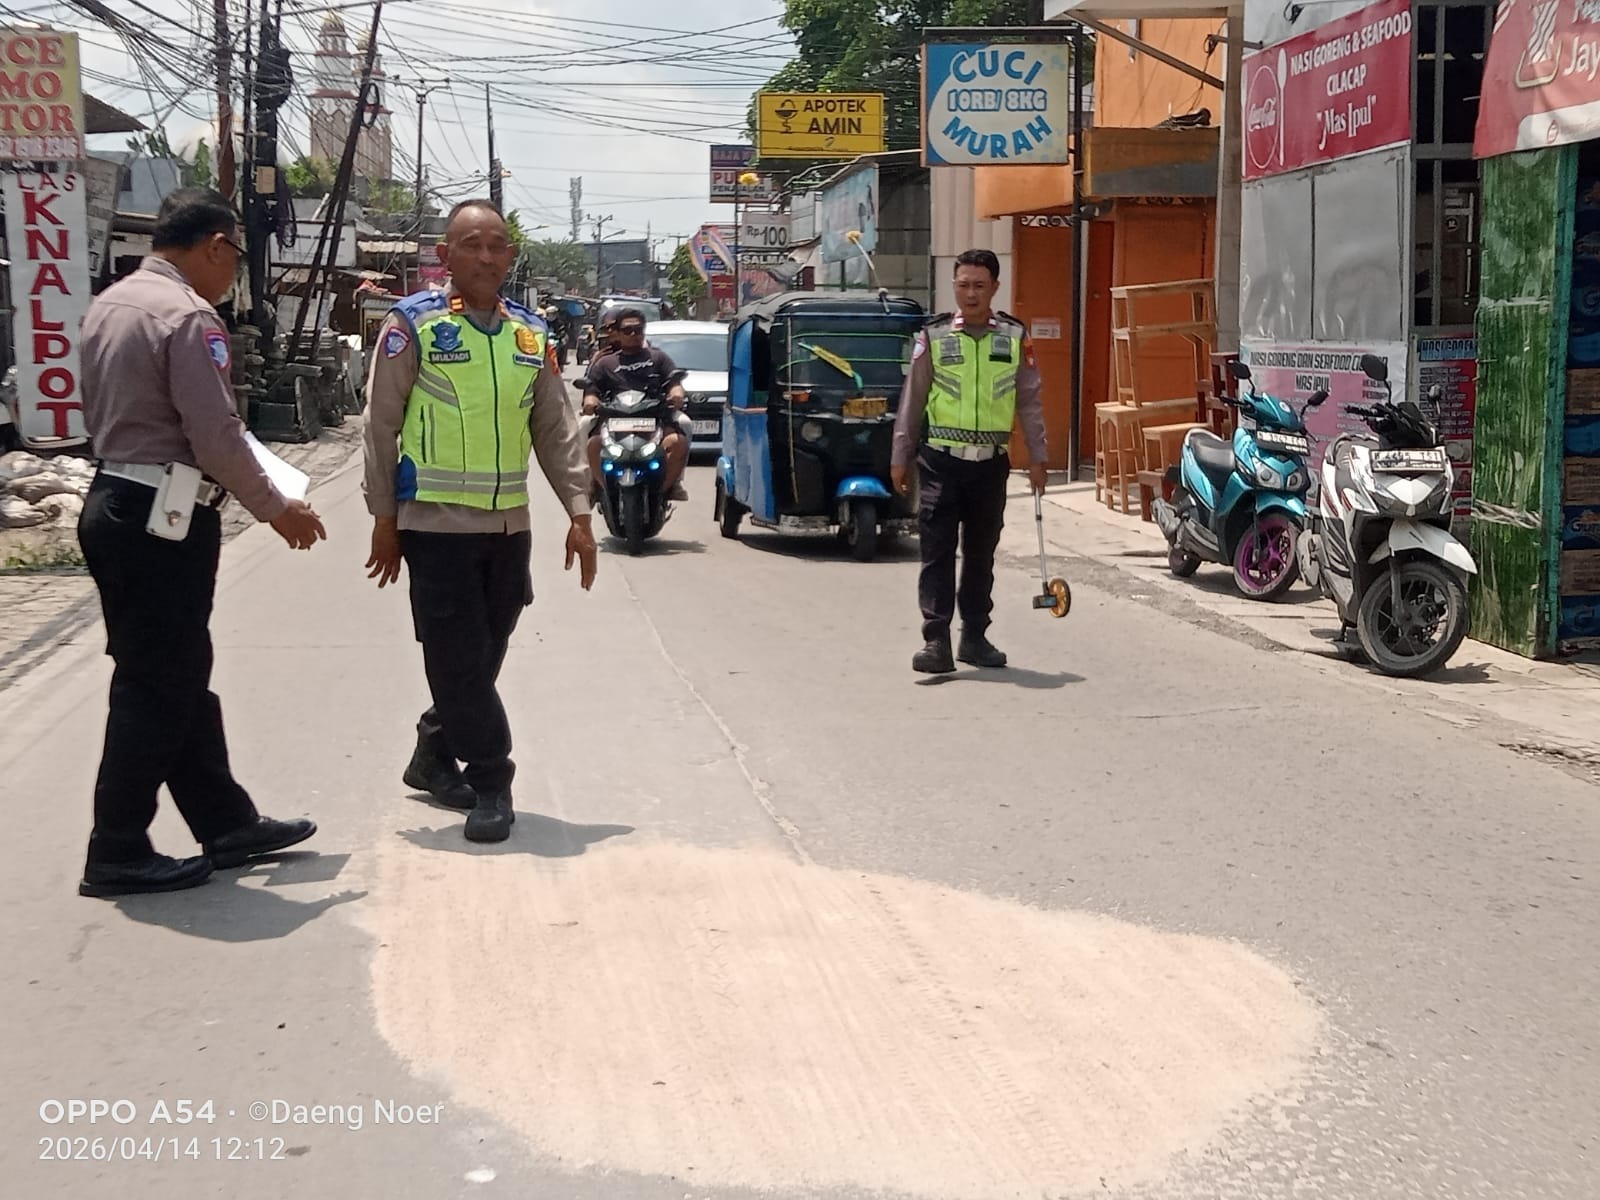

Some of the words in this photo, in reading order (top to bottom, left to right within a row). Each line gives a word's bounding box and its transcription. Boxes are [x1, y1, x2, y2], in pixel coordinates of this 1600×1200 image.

[0, 36, 64, 66] CE
[1290, 53, 1313, 76] NASI
[1314, 33, 1350, 68] GORENG
[1352, 30, 1361, 53] &
[1361, 10, 1412, 49] SEAFOOD
[952, 50, 1043, 85] CUCI
[1326, 64, 1367, 97] CILACAP
[803, 99, 866, 113] APOTEK
[1005, 89, 1047, 111] 8KG
[0, 104, 75, 132] TOR
[808, 117, 862, 134] AMIN
[942, 115, 1052, 159] MURAH
[17, 173, 76, 192] LAS
[22, 192, 82, 437] KNALPOT
[1314, 353, 1352, 371] SEAFOOD
[1296, 374, 1313, 391] MAS
